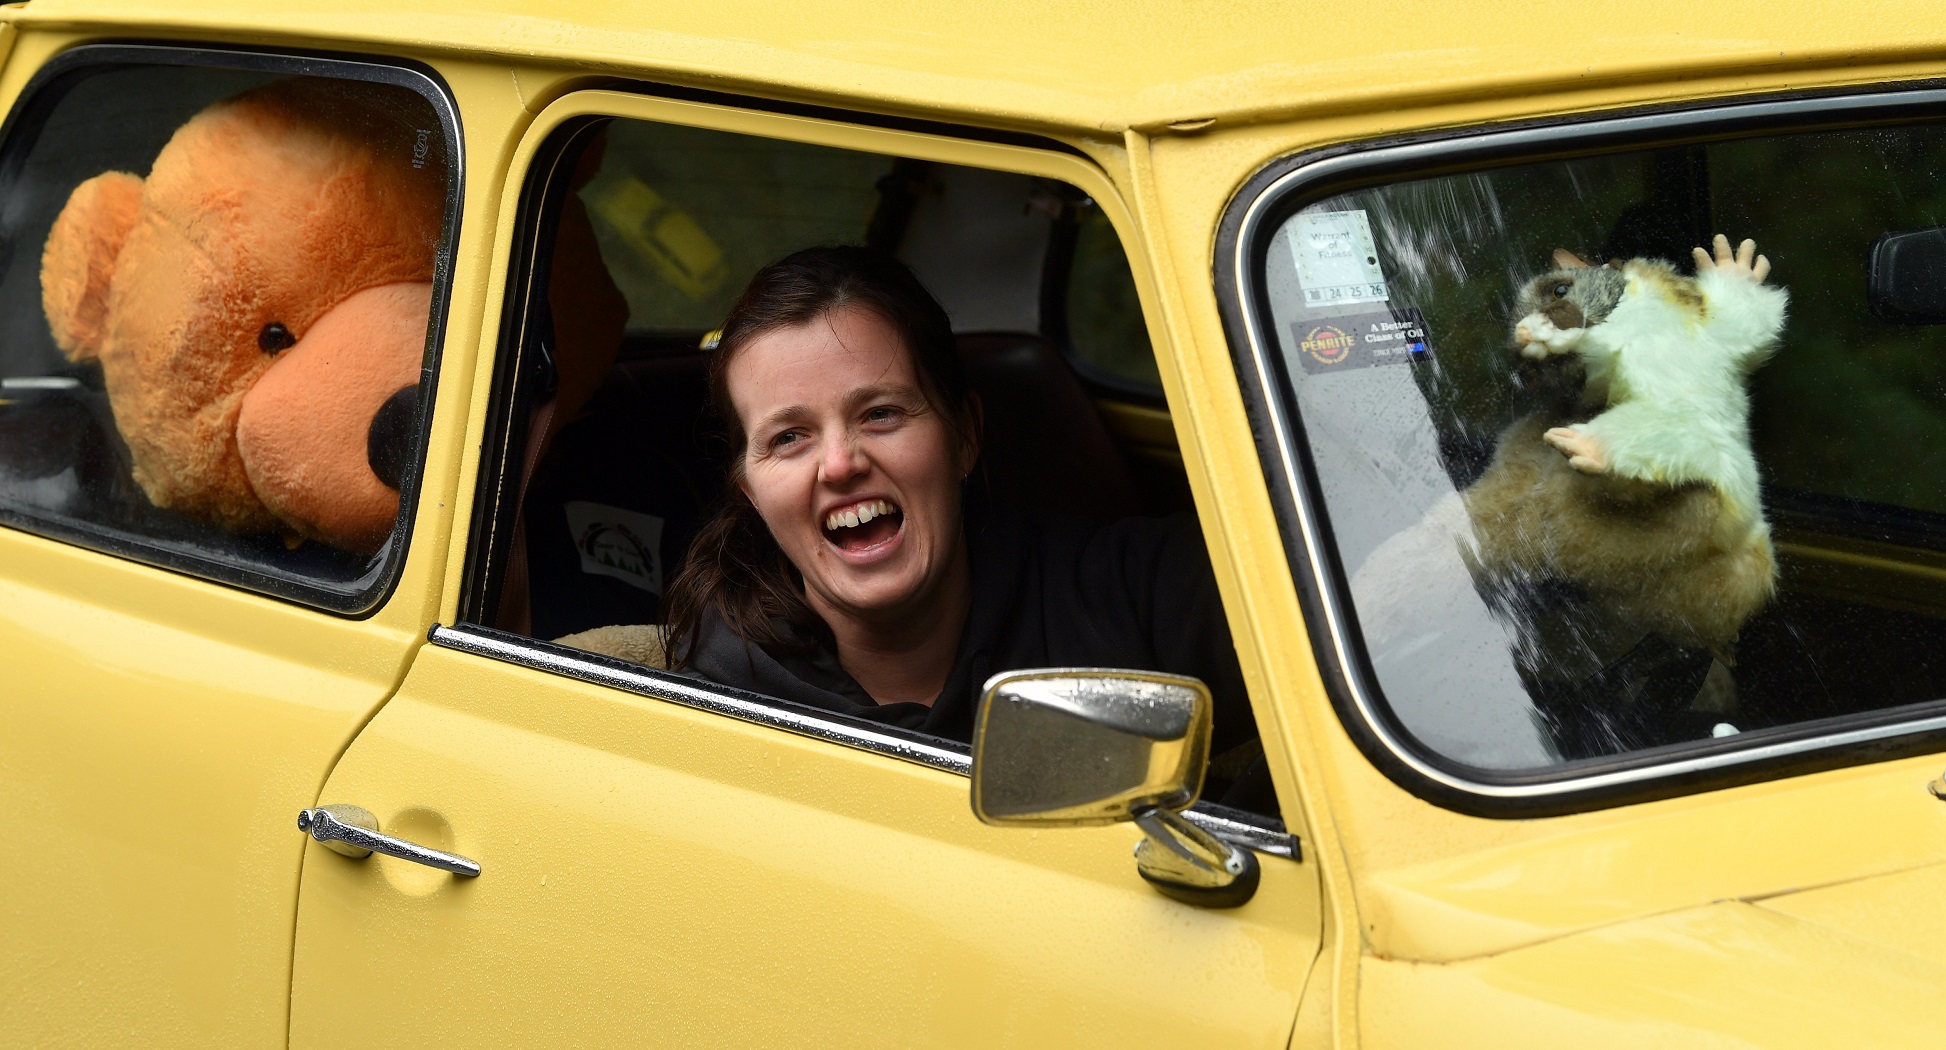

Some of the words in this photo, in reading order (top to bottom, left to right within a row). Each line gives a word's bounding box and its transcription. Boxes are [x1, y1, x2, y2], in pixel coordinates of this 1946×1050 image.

[1311, 232, 1351, 241] Warrant
[1328, 240, 1338, 249] of
[1318, 250, 1353, 260] Fitness
[1330, 288, 1342, 299] 24
[1350, 286, 1362, 297] 25
[1370, 285, 1382, 295] 26
[1370, 323, 1380, 333] A
[1380, 321, 1413, 332] Better
[1365, 332, 1394, 343] Class
[1394, 330, 1406, 340] of
[1406, 328, 1425, 339] Oil
[1300, 335, 1355, 353] PENRITE
